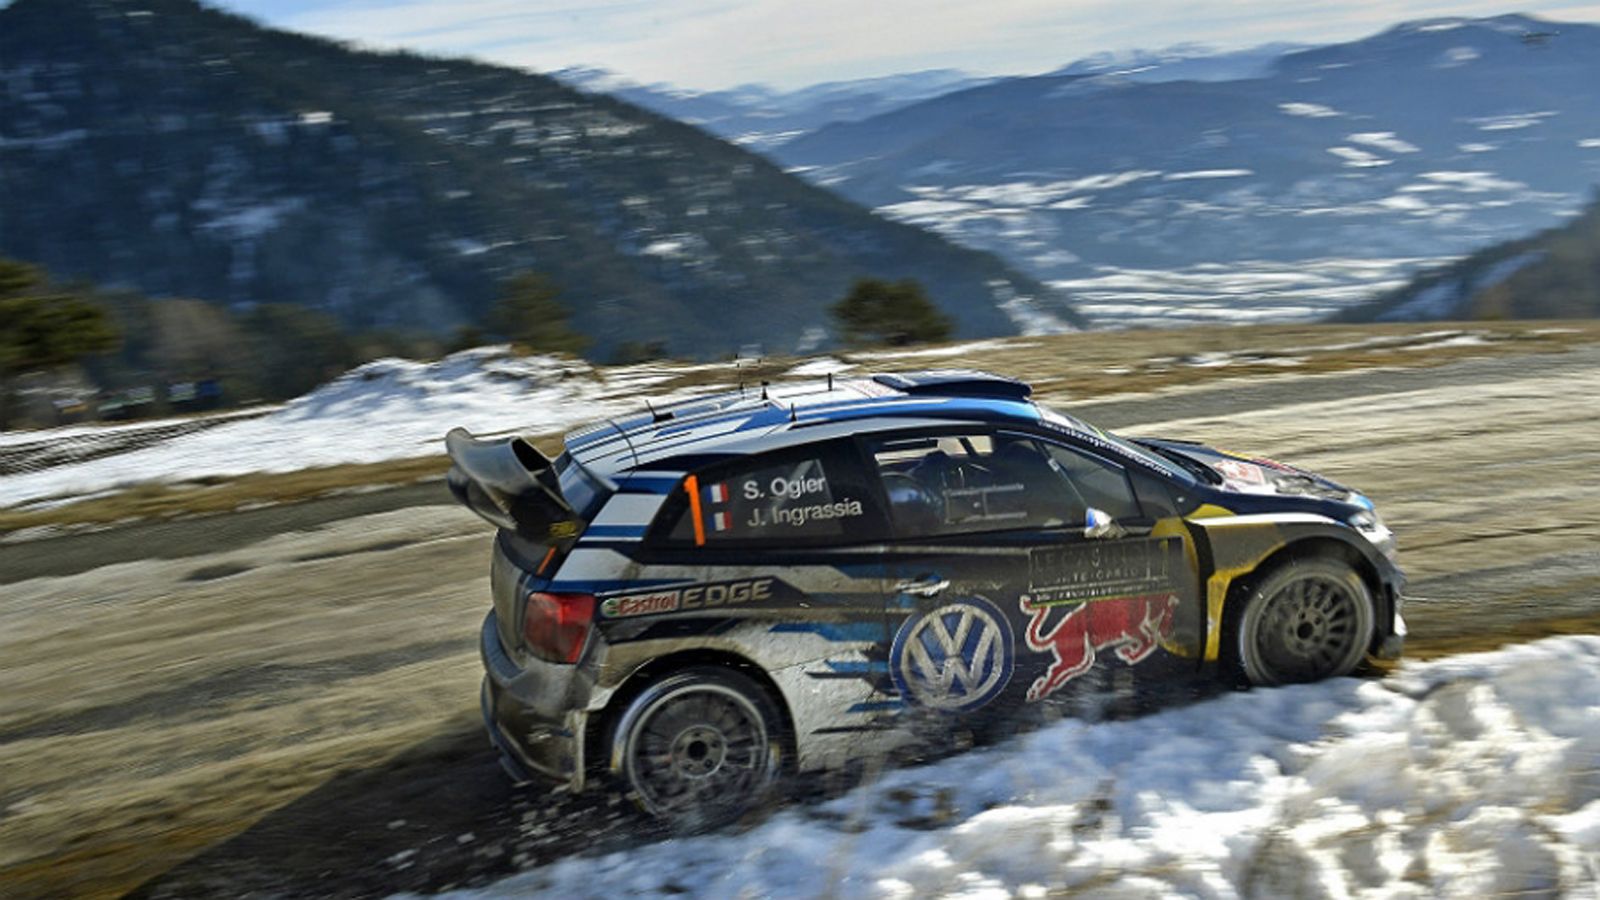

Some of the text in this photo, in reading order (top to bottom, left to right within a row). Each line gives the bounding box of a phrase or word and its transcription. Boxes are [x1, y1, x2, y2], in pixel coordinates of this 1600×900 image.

[743, 475, 826, 499] S. Ogier
[683, 474, 706, 546] 1
[747, 498, 863, 527] J. Ingrassia
[619, 579, 774, 615] Castrol EDGE
